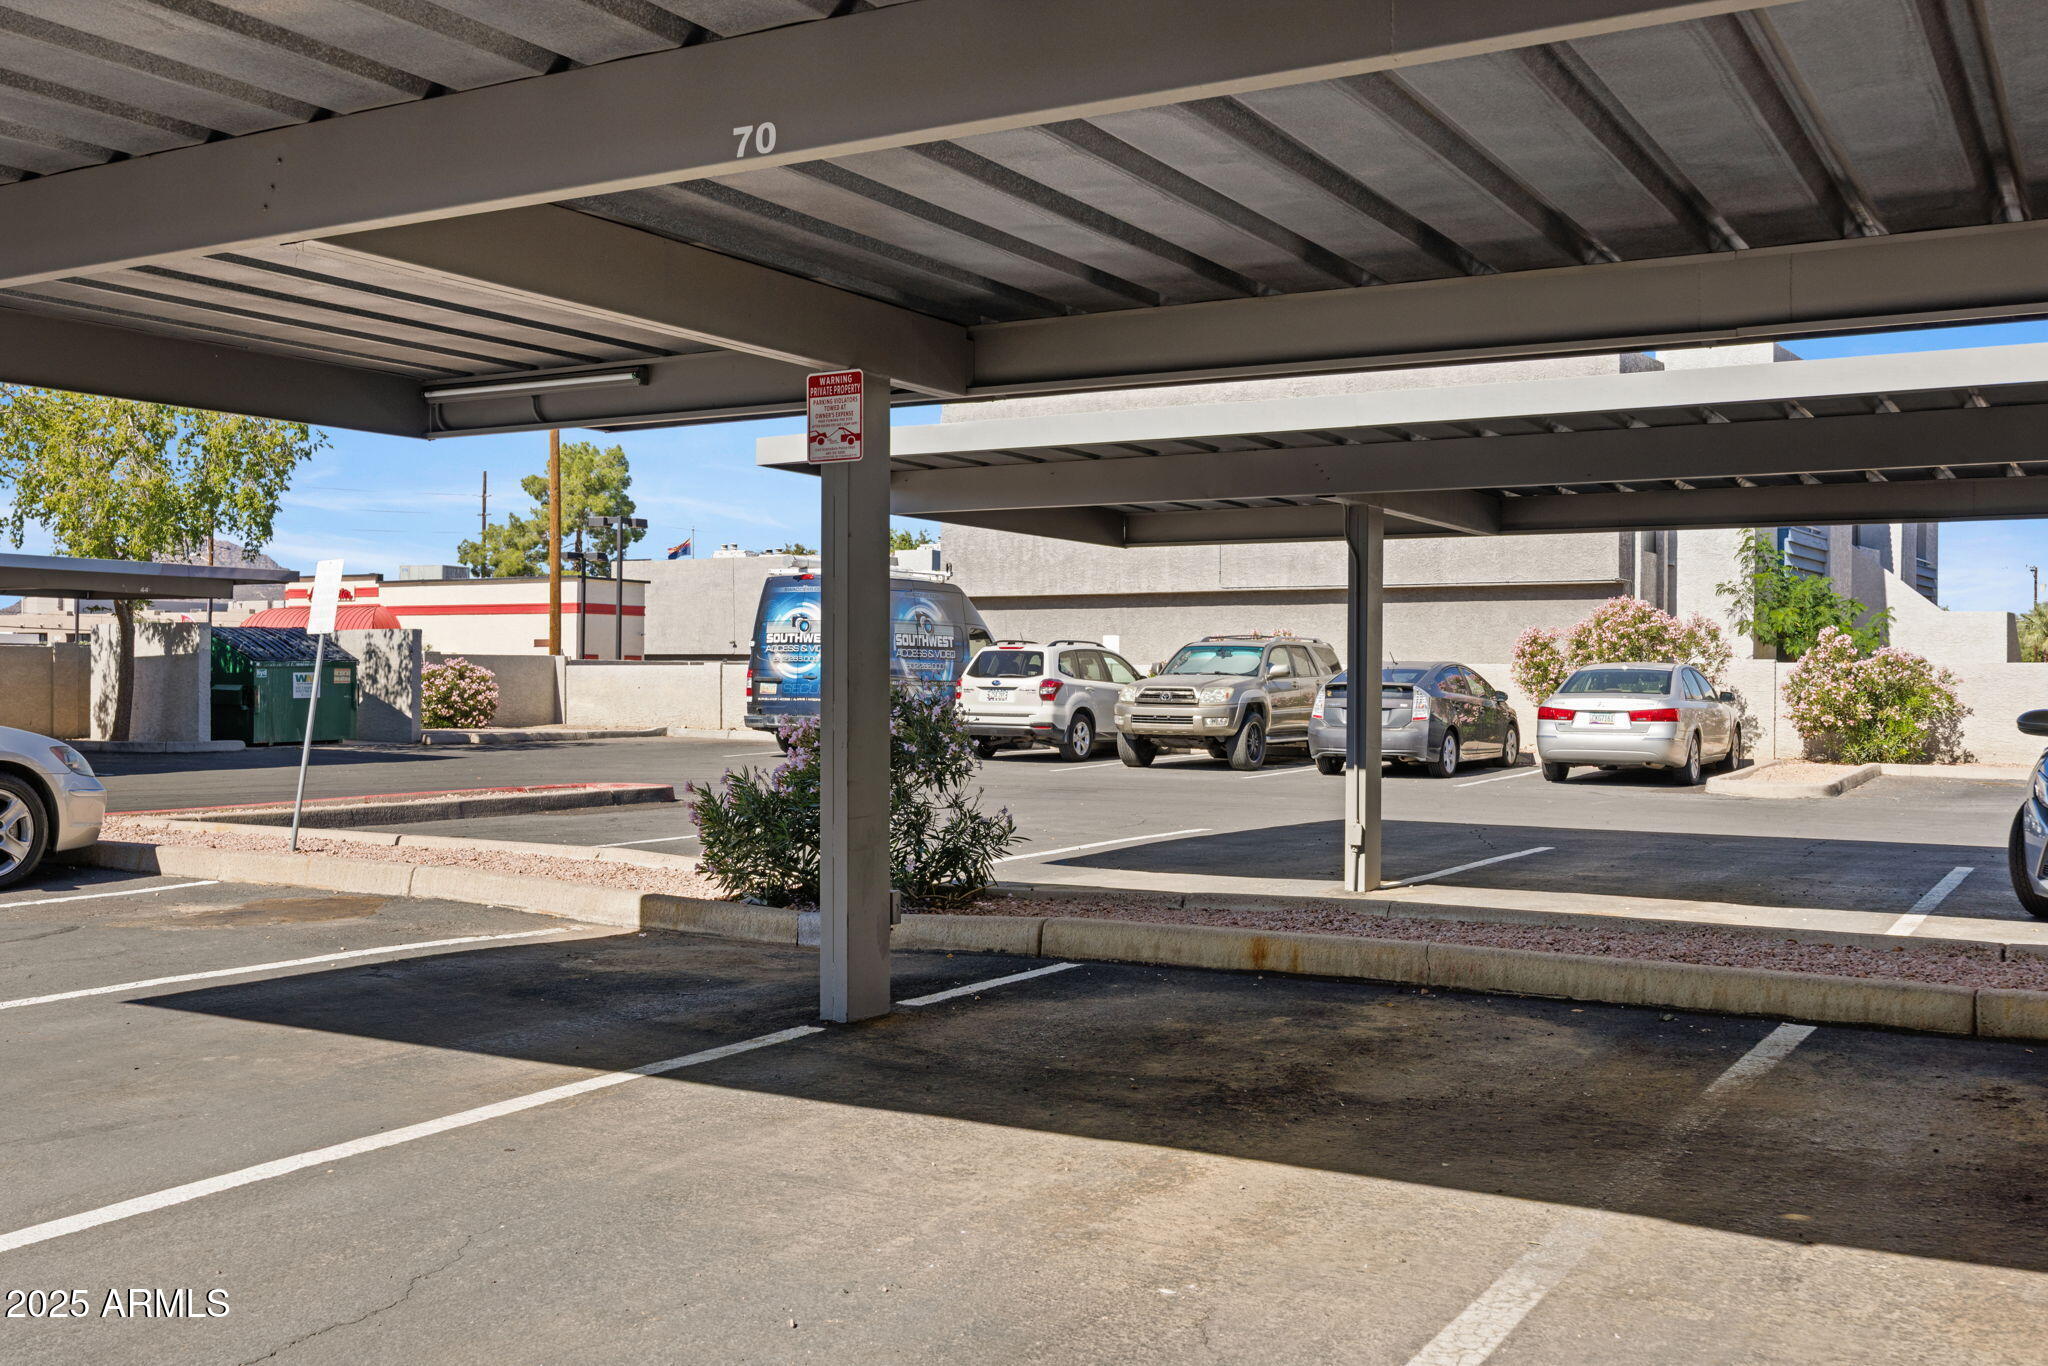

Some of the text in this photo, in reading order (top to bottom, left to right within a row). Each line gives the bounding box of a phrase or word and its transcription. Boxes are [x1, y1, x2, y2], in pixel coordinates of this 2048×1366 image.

[732, 121, 777, 158] 70
[820, 375, 852, 385] WARNING
[810, 383, 861, 396] PRIVATE PROPERTY
[813, 398, 833, 406] PARKING
[815, 410, 854, 420] OWNER'S EXPENSE
[766, 633, 821, 643] SOUTHWE
[895, 633, 954, 648] SOUTHWEST
[765, 644, 800, 652] ACCESS
[801, 644, 808, 652] &
[896, 648, 956, 658] ACCESS & VIDEO
[782, 682, 820, 694] SECU
